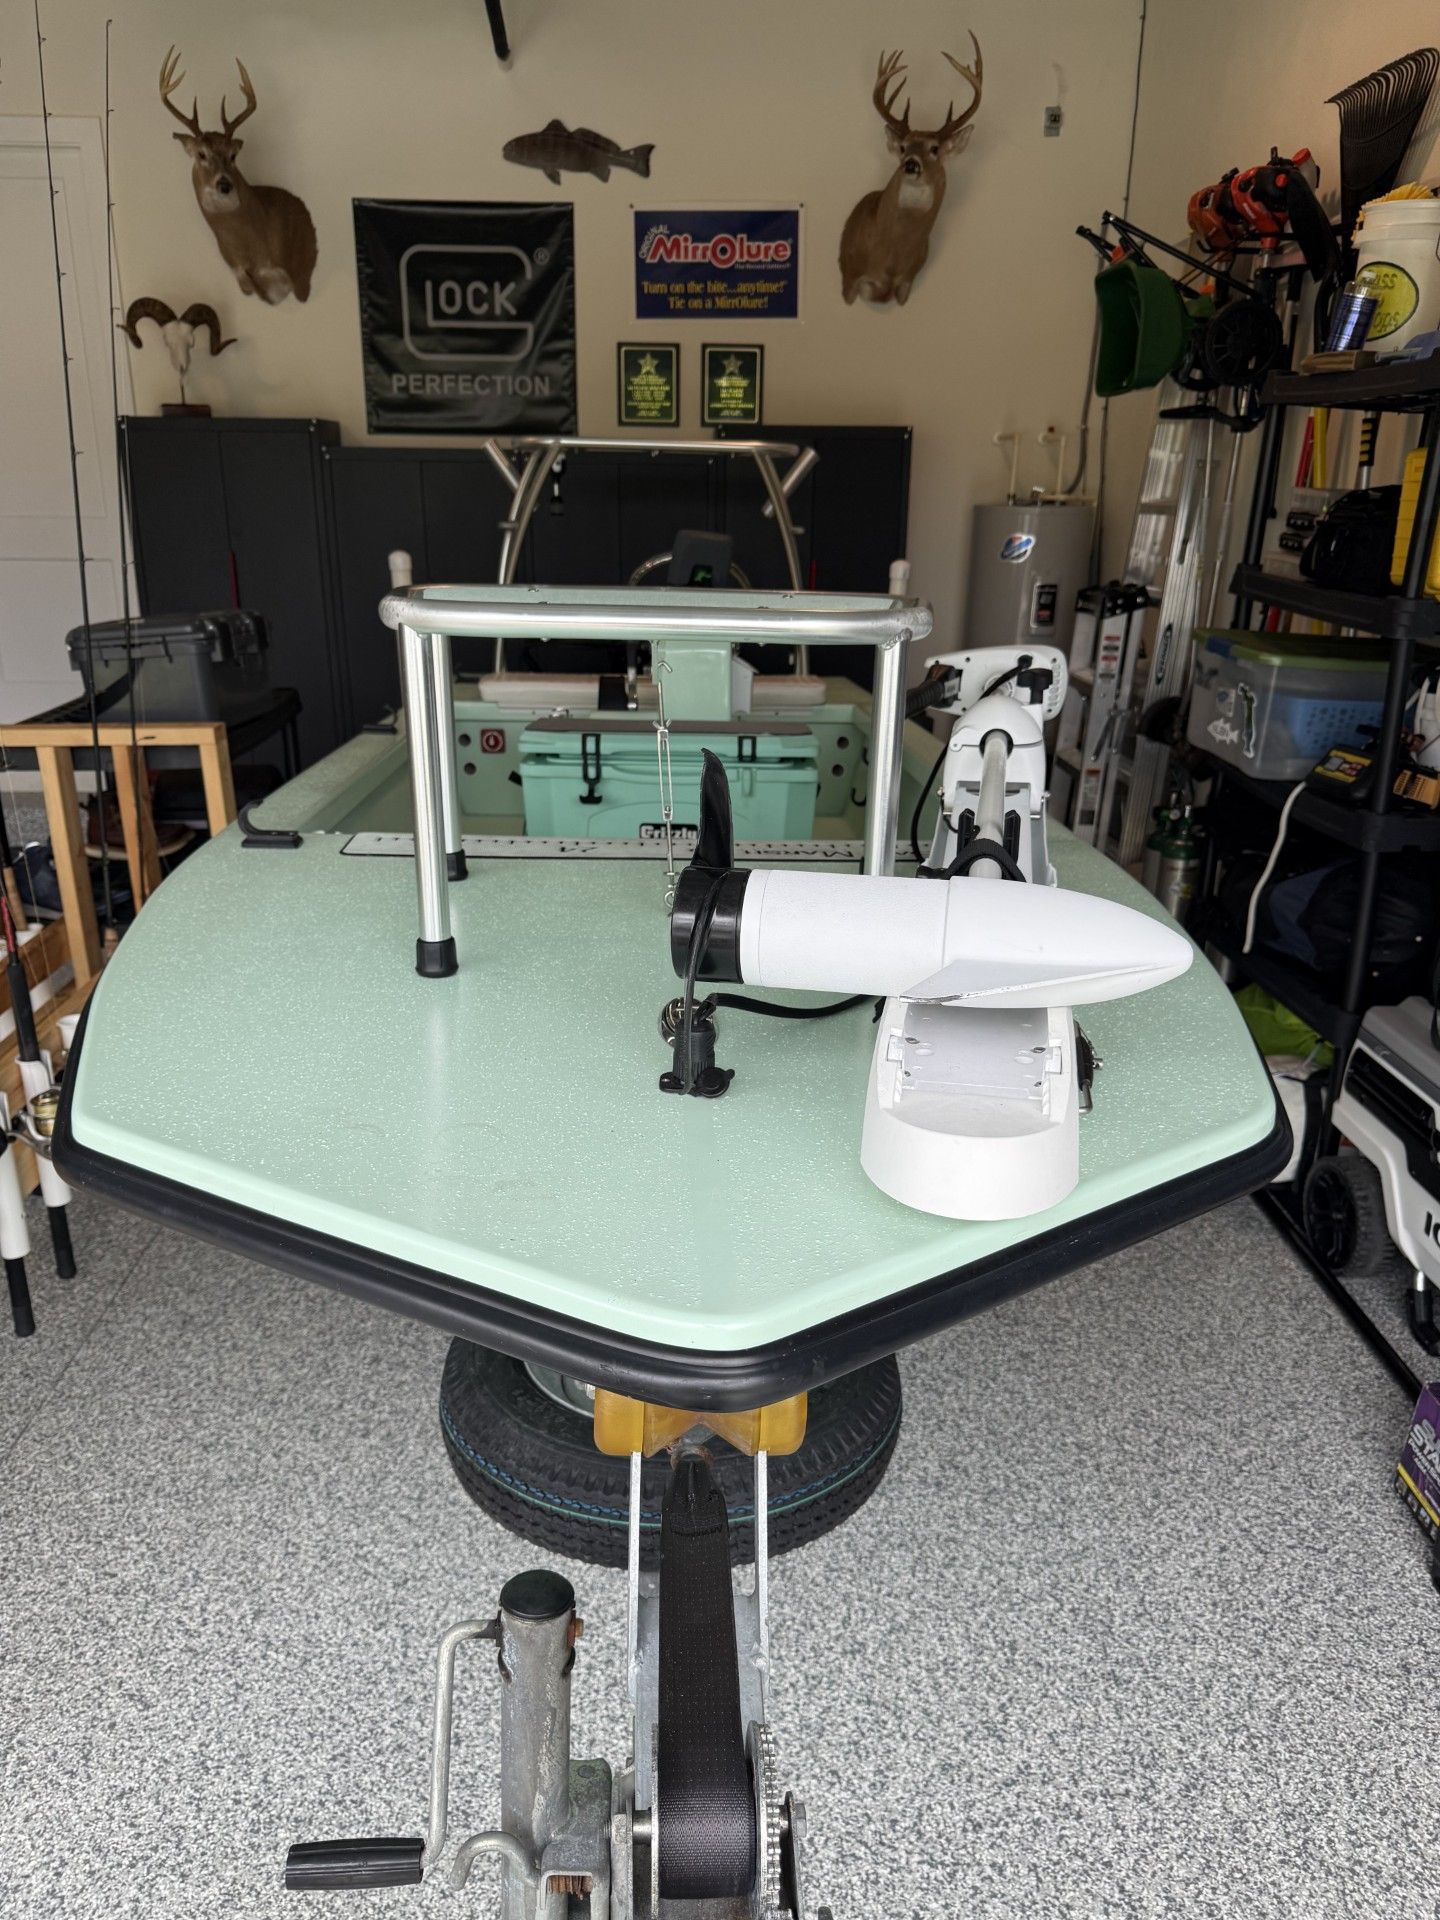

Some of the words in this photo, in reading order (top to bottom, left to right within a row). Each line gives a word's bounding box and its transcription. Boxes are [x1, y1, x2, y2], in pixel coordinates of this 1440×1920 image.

[646, 233, 790, 269] MirrOlure
[670, 283, 685, 294] on
[687, 280, 704, 294] the
[667, 296, 685, 309] Tie
[687, 298, 703, 309] on
[391, 373, 550, 396] PERFECTION
